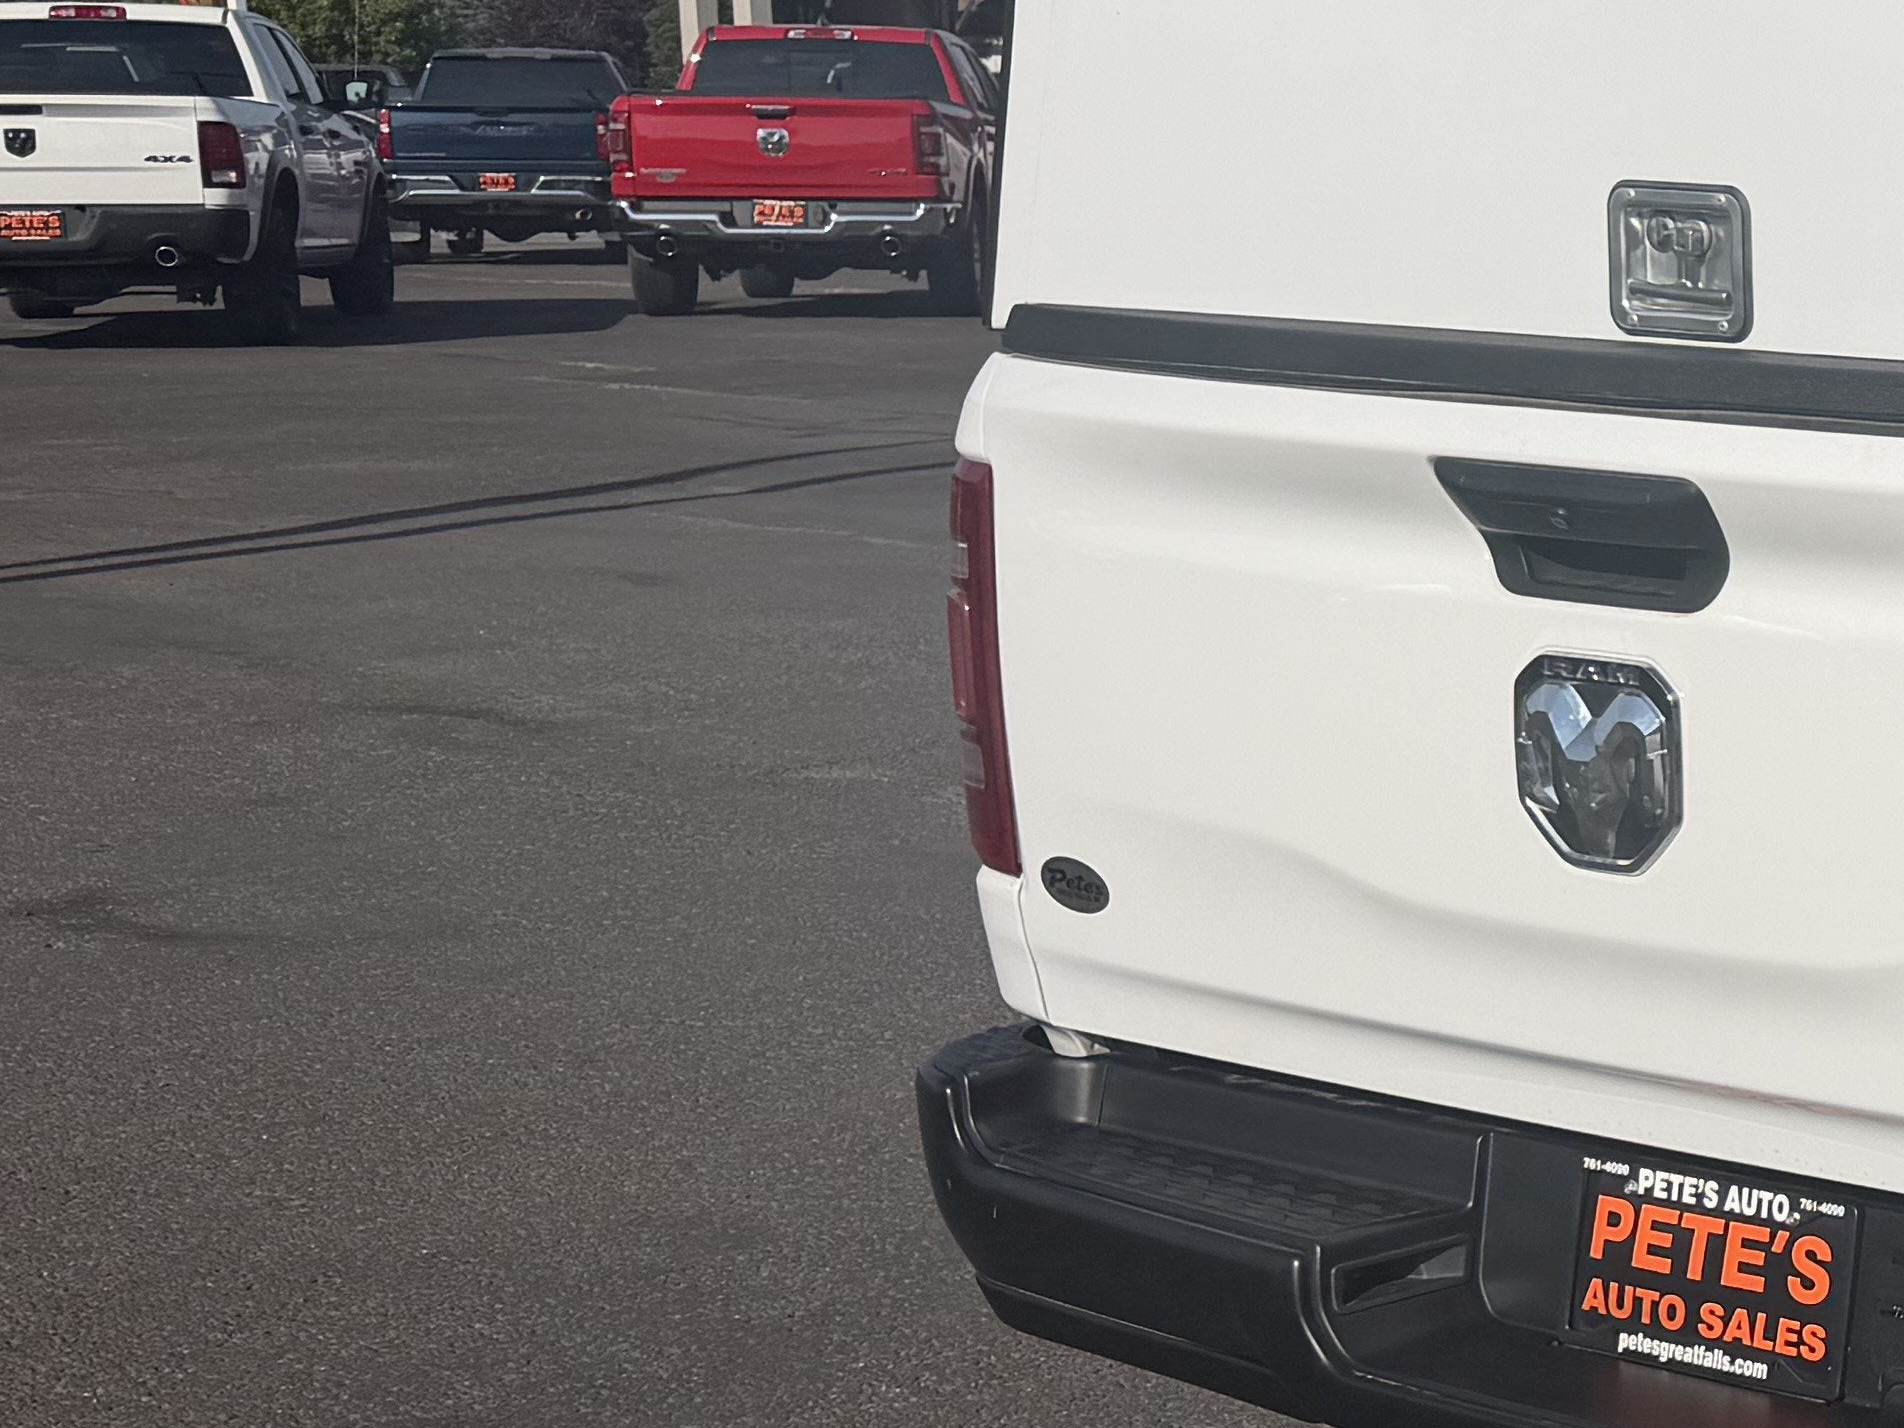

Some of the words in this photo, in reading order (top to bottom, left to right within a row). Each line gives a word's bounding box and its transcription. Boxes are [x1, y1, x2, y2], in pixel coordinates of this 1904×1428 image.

[1583, 1157, 1630, 1176] 761-4090
[1637, 1168, 1719, 1209] PETE'S
[1724, 1185, 1790, 1222] AUTO
[1799, 1198, 1845, 1217] 761-4090
[1588, 1194, 1833, 1306] PETE'S
[1581, 1277, 1686, 1331] AUTO
[1697, 1302, 1828, 1362] SALES
[1617, 1331, 1769, 1380] petesgreatfalls.com
